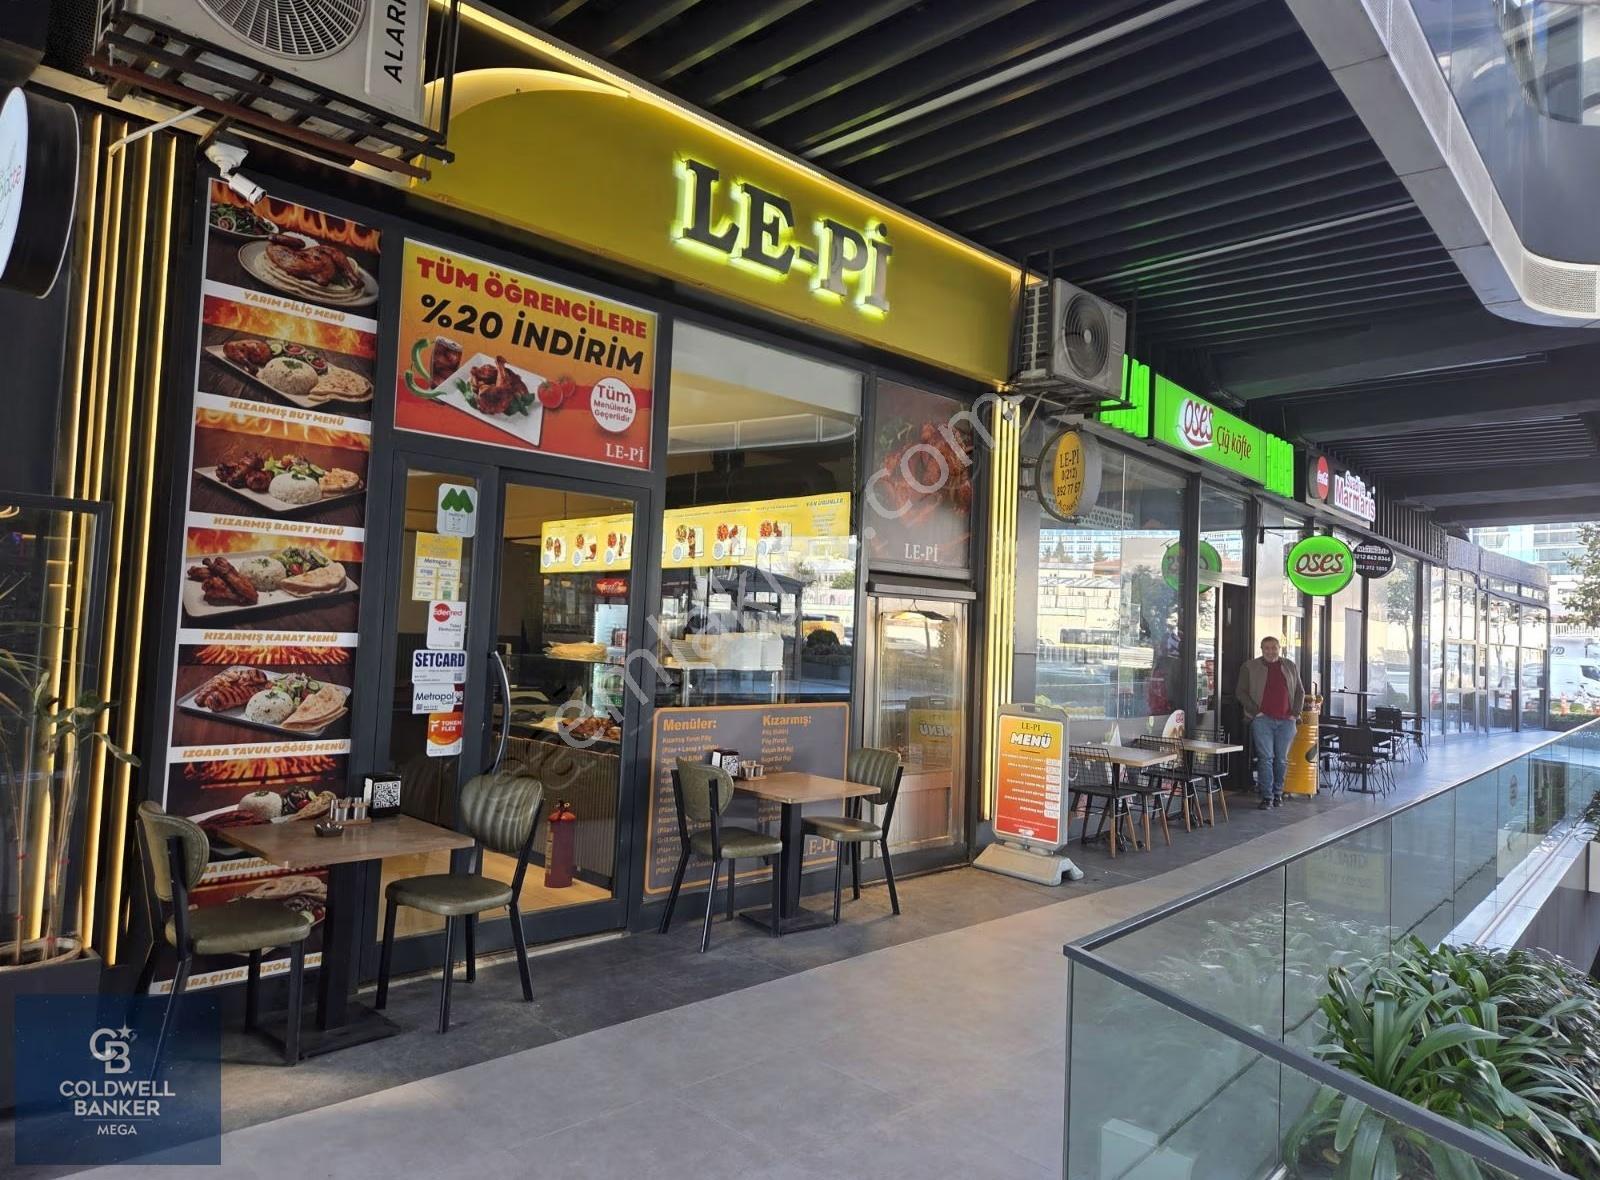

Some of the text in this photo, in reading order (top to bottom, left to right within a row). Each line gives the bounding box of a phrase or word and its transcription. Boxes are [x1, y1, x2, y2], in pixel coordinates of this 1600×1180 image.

[383, 0, 407, 84] ALAR
[244, 292, 345, 322] YARIM PİLİÇ MENÜ
[416, 256, 647, 339] TÜM ÖĞRENCİLERE
[420, 294, 644, 375] %20 İNDİRİM
[597, 385, 631, 404] Tüm
[229, 400, 344, 426] KIZARMIŞ BUT MENÜ
[593, 399, 633, 414] Menülerde
[594, 409, 630, 422] Geçerlidir
[1184, 399, 1251, 460] oses Çiğ köfte
[1334, 474, 1376, 522] Marmaris
[213, 516, 344, 536] KIZARMIŞ BAGET MENÜ
[1295, 552, 1345, 573] oses
[204, 631, 338, 643] KIZARMIŞ KANAT MENÜ
[415, 652, 466, 668] SETCARD
[415, 691, 454, 703] Metropol
[663, 718, 717, 731] Menüler:
[763, 715, 812, 727] Kızarmış:
[183, 739, 347, 758] IZGARA TAVUK GÖĞÜS MENÜ
[1010, 732, 1052, 749] MENÜ
[208, 969, 244, 986] ÇITIR
